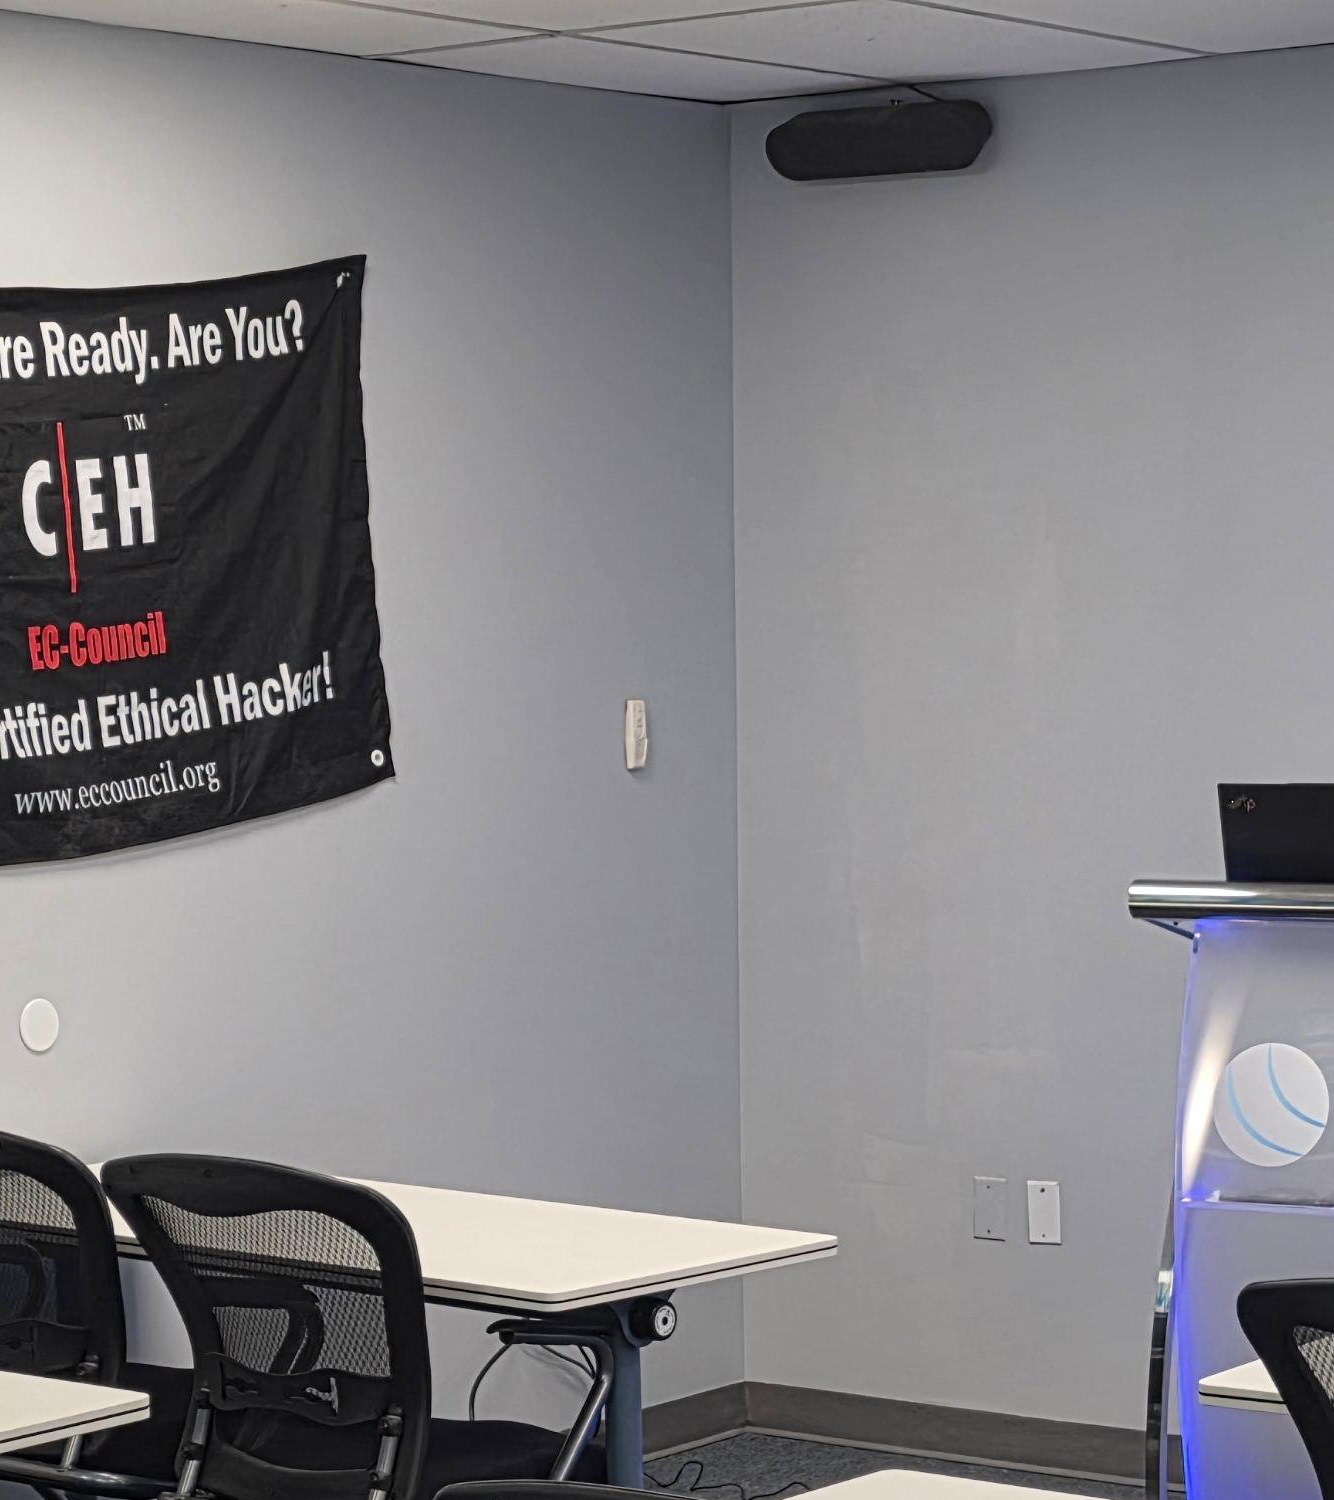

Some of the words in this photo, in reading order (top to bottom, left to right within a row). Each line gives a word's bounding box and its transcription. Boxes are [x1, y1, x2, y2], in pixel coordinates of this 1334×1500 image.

[39, 316, 160, 385] Ready.
[167, 312, 223, 369] Are
[224, 299, 305, 361] You?
[27, 610, 168, 672] EC-Council
[96, 678, 212, 748] Ethical
[212, 650, 334, 726] Hacker!
[14, 756, 222, 816] www.eccouncil.org
